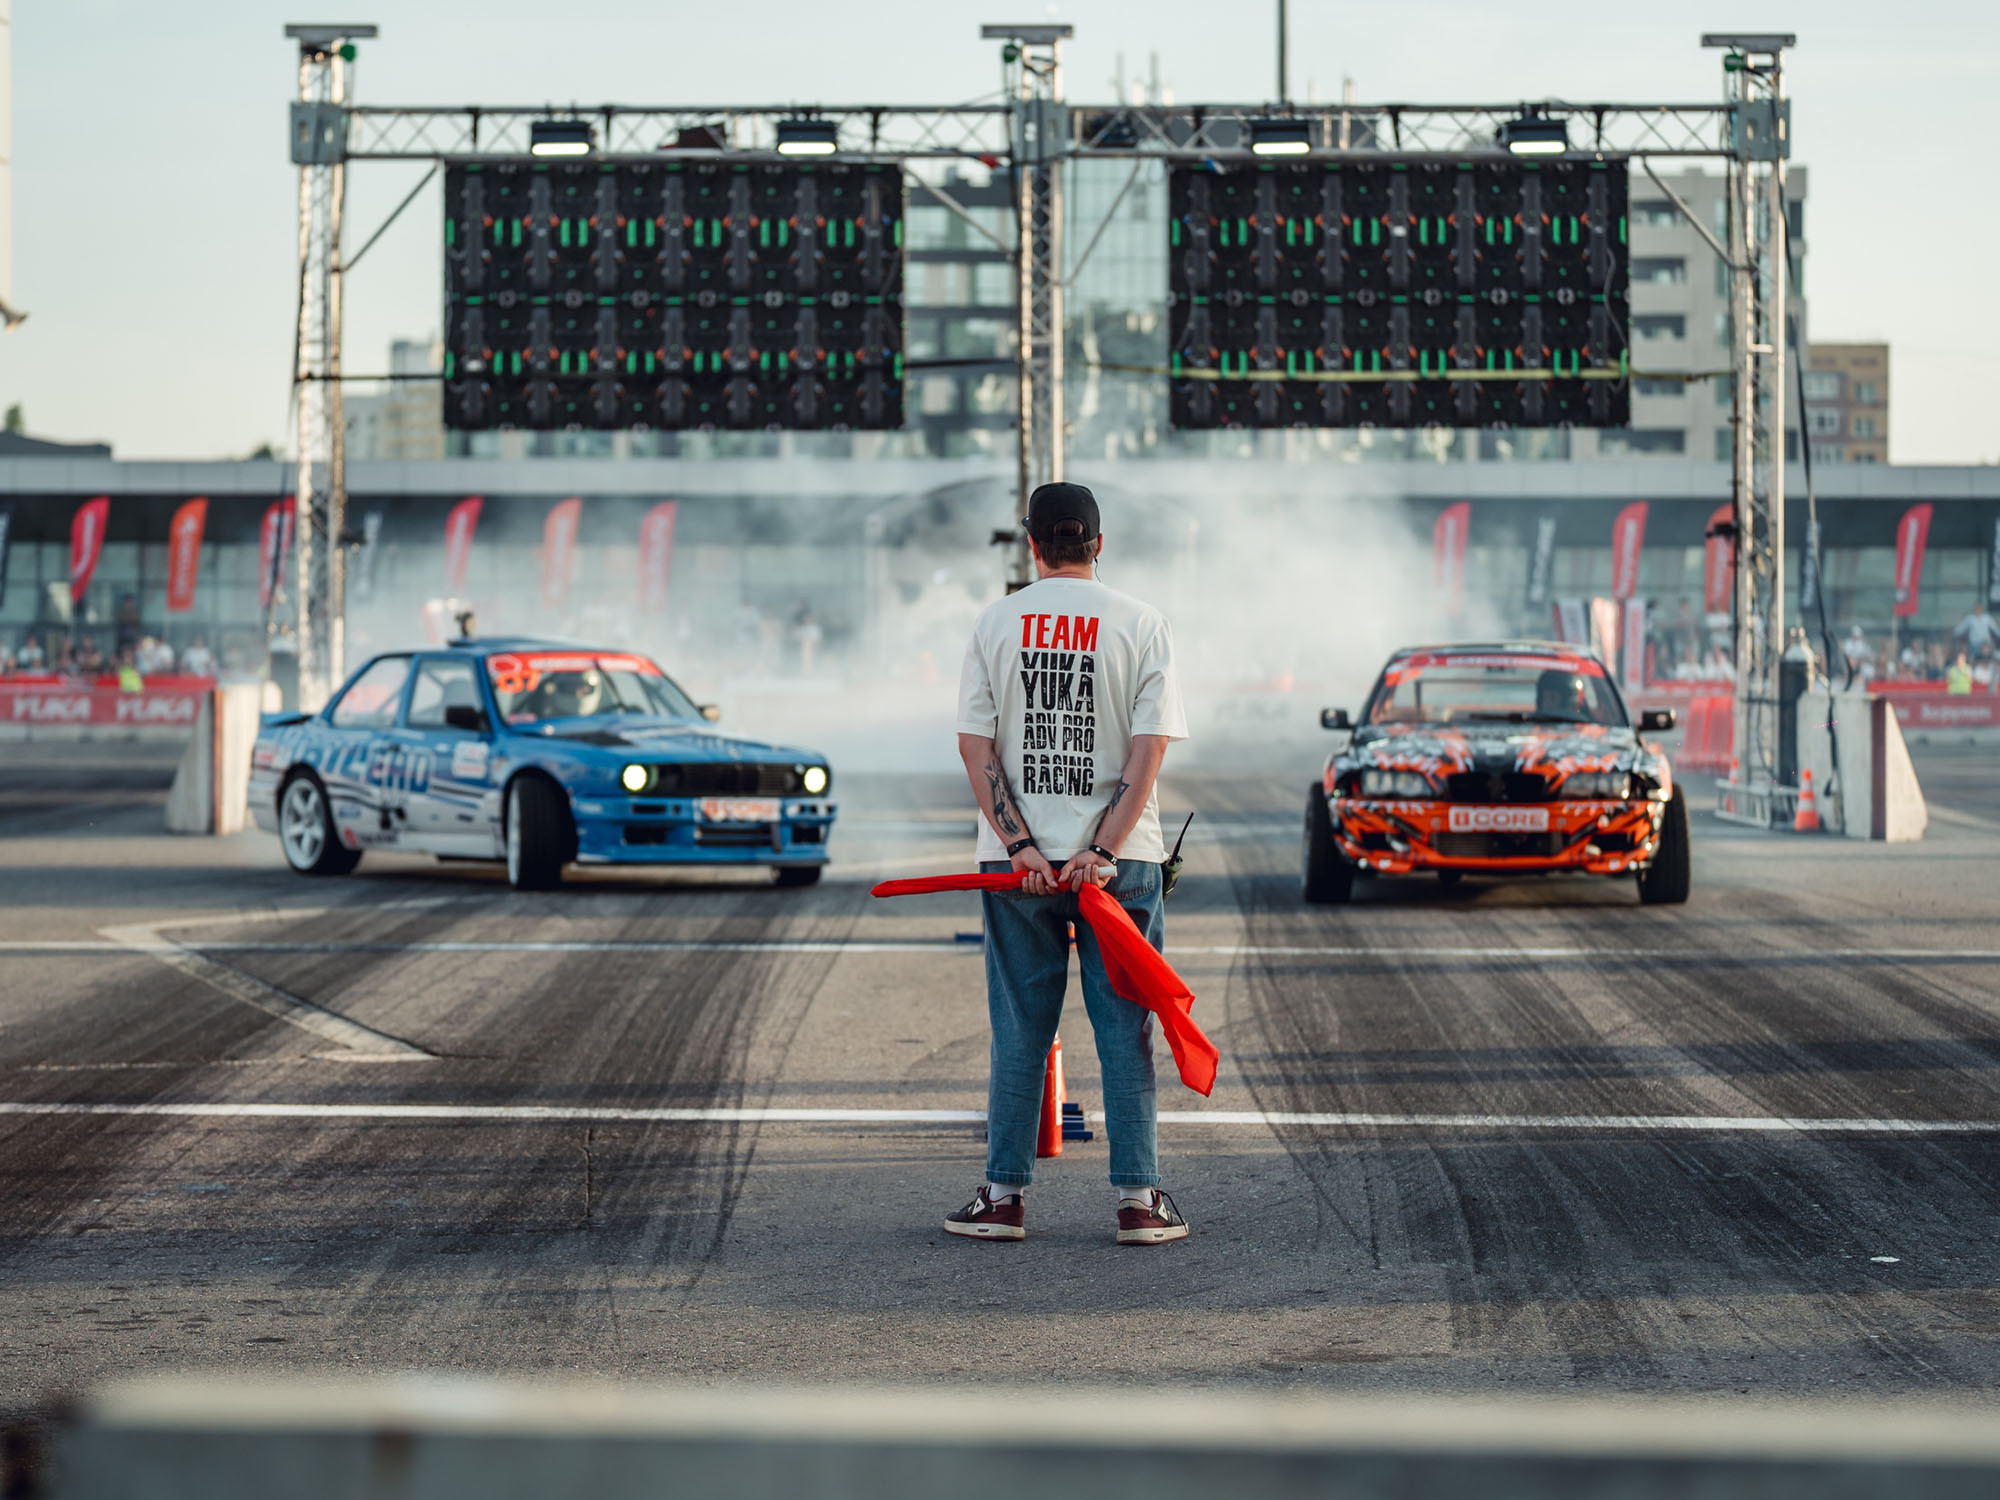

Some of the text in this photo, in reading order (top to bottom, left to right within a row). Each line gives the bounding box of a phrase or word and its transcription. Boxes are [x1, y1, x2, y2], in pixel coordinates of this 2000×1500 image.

[1021, 614, 1099, 652] TEAM
[1020, 671, 1094, 713] YUKA
[13, 696, 91, 720] YUKA
[116, 696, 194, 720] YUKA
[1023, 725, 1095, 753] ADV PRO
[1023, 765, 1094, 796] RACING
